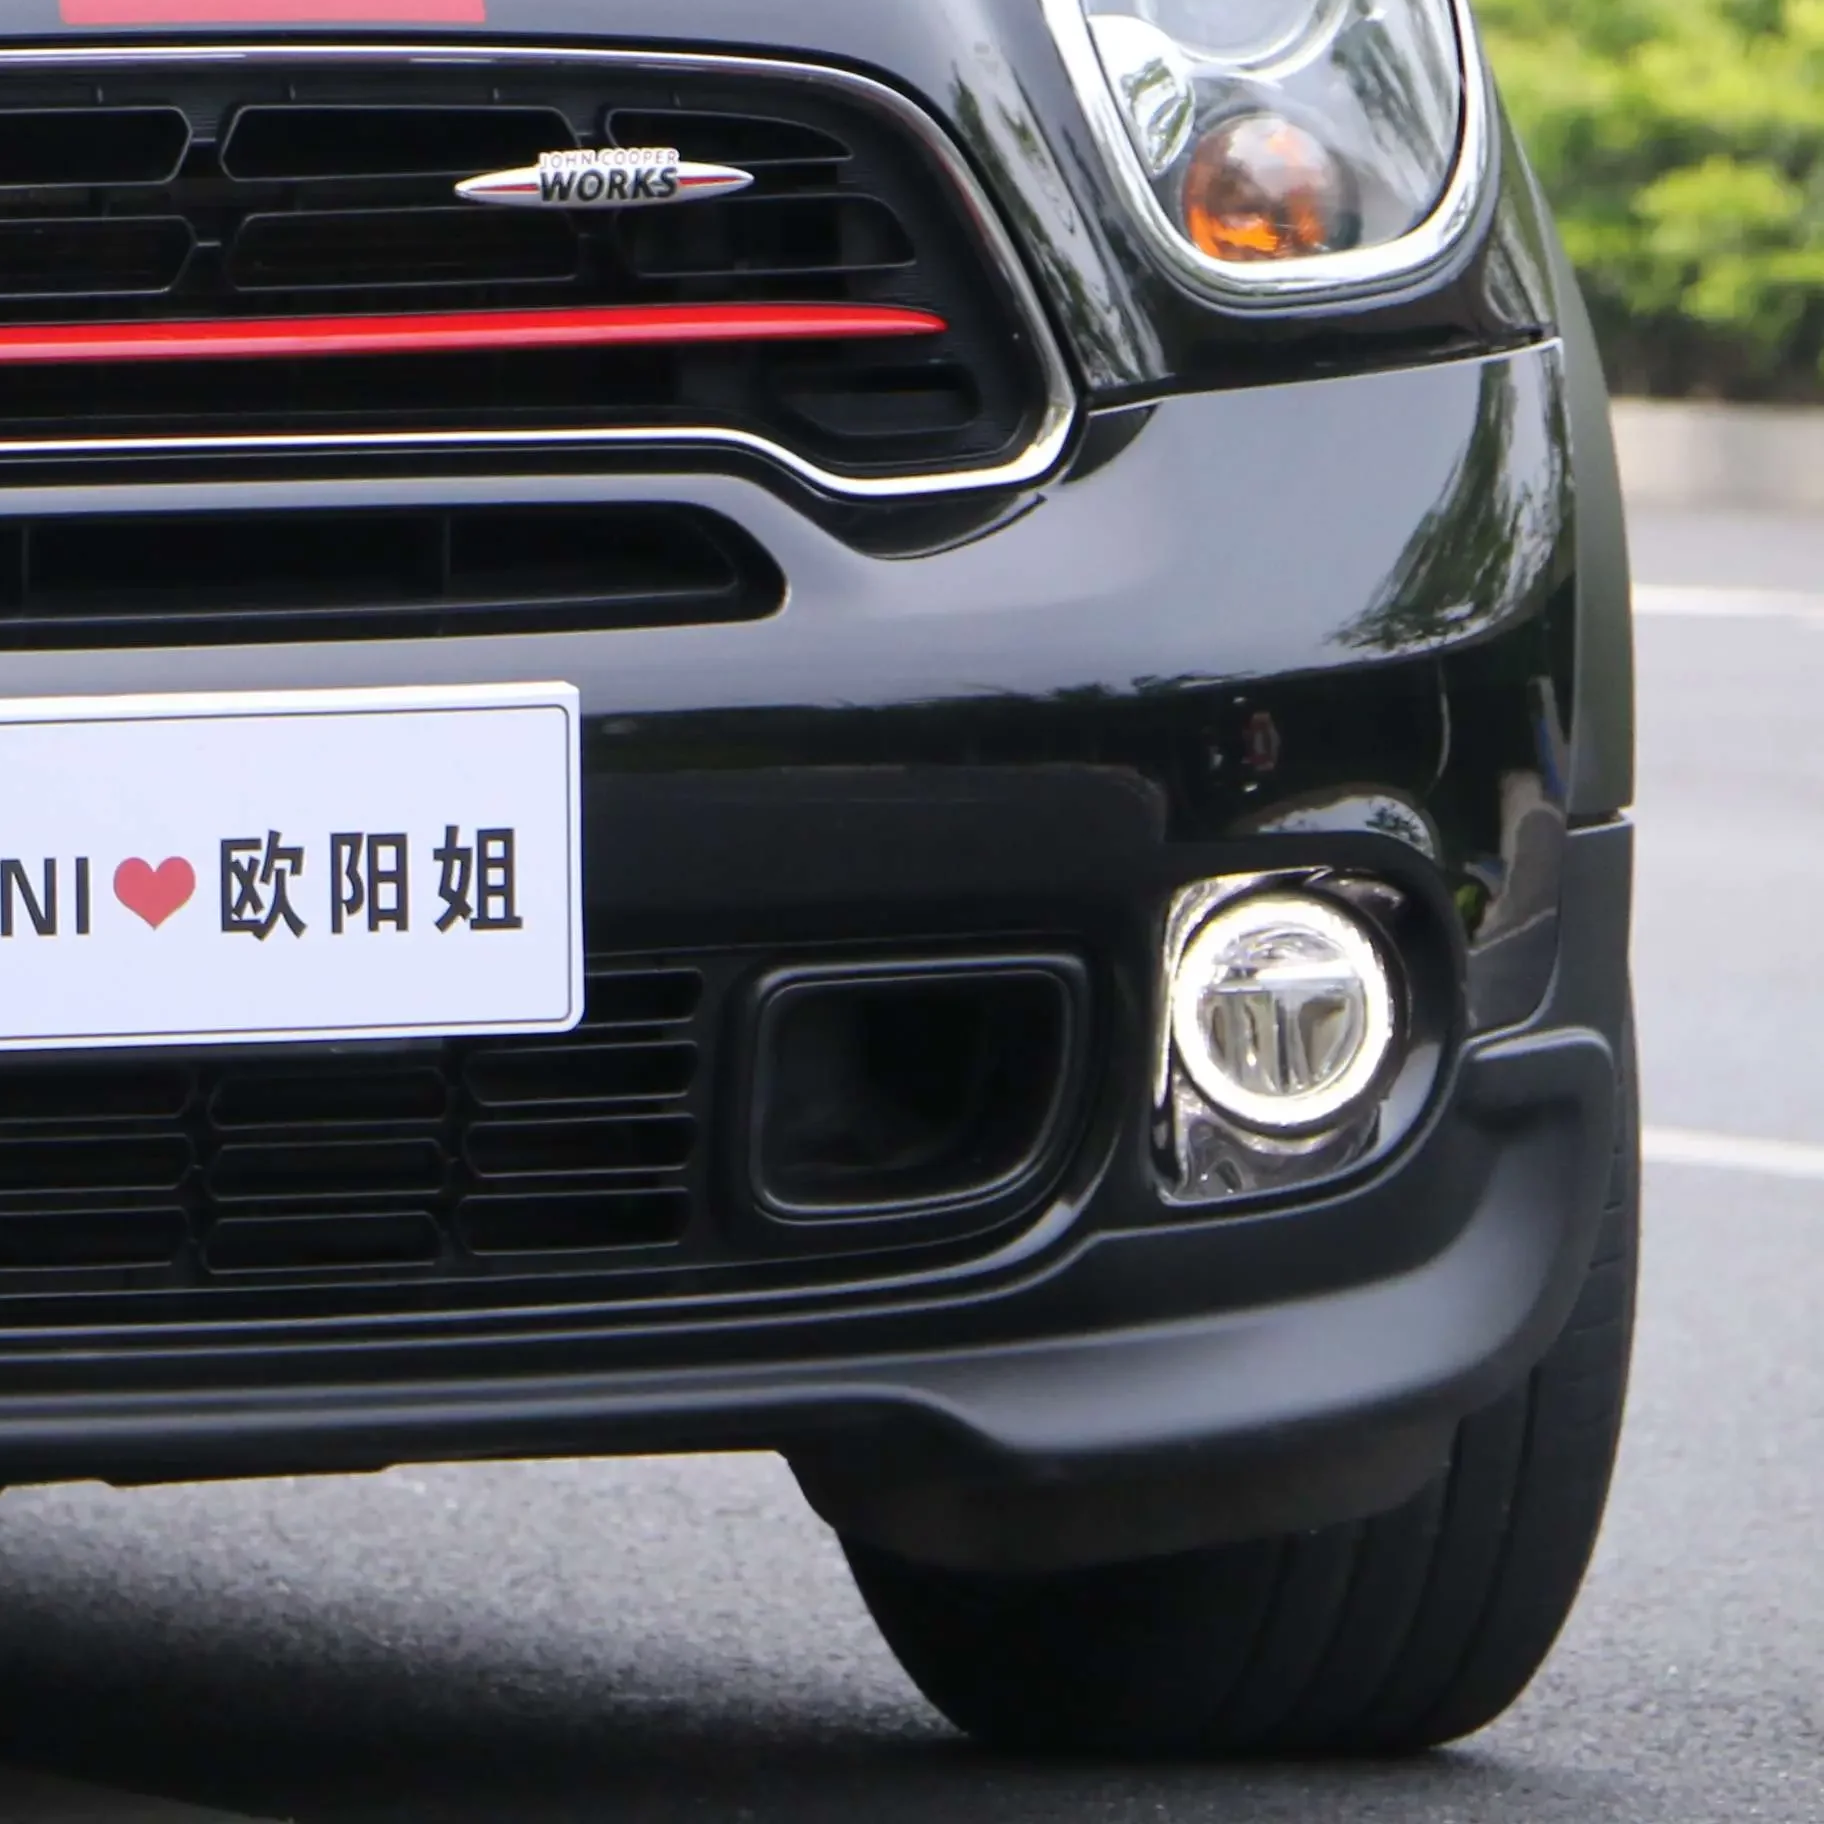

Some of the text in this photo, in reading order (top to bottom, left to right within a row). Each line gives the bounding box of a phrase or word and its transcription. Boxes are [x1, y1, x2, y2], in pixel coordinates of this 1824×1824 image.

[539, 149, 678, 168] JOHN COOPER
[539, 166, 679, 201] WORKS
[218, 822, 523, 943] 欧阳姐
